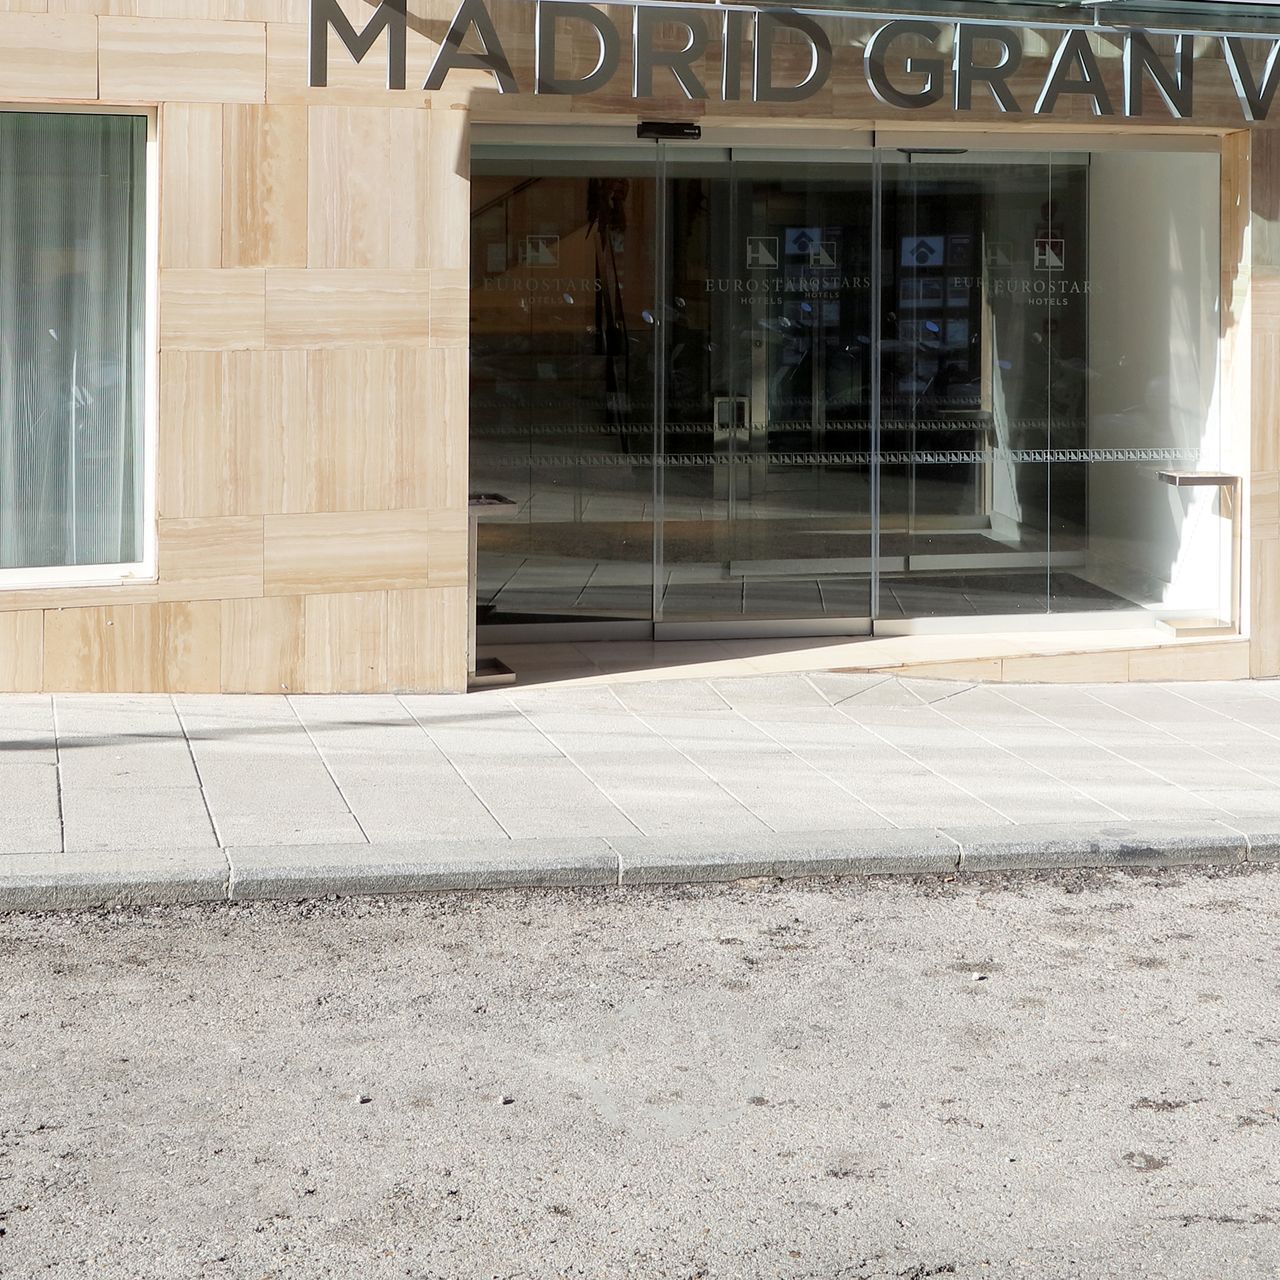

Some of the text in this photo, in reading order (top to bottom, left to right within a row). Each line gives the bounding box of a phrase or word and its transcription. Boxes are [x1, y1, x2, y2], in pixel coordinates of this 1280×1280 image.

[864, 19, 1195, 118] GRAN
[483, 278, 602, 293] EUROSTARS
[705, 278, 820, 293] EUROSTARS
[741, 297, 783, 305] HOTELS
[1028, 298, 1069, 306] HOTELS
